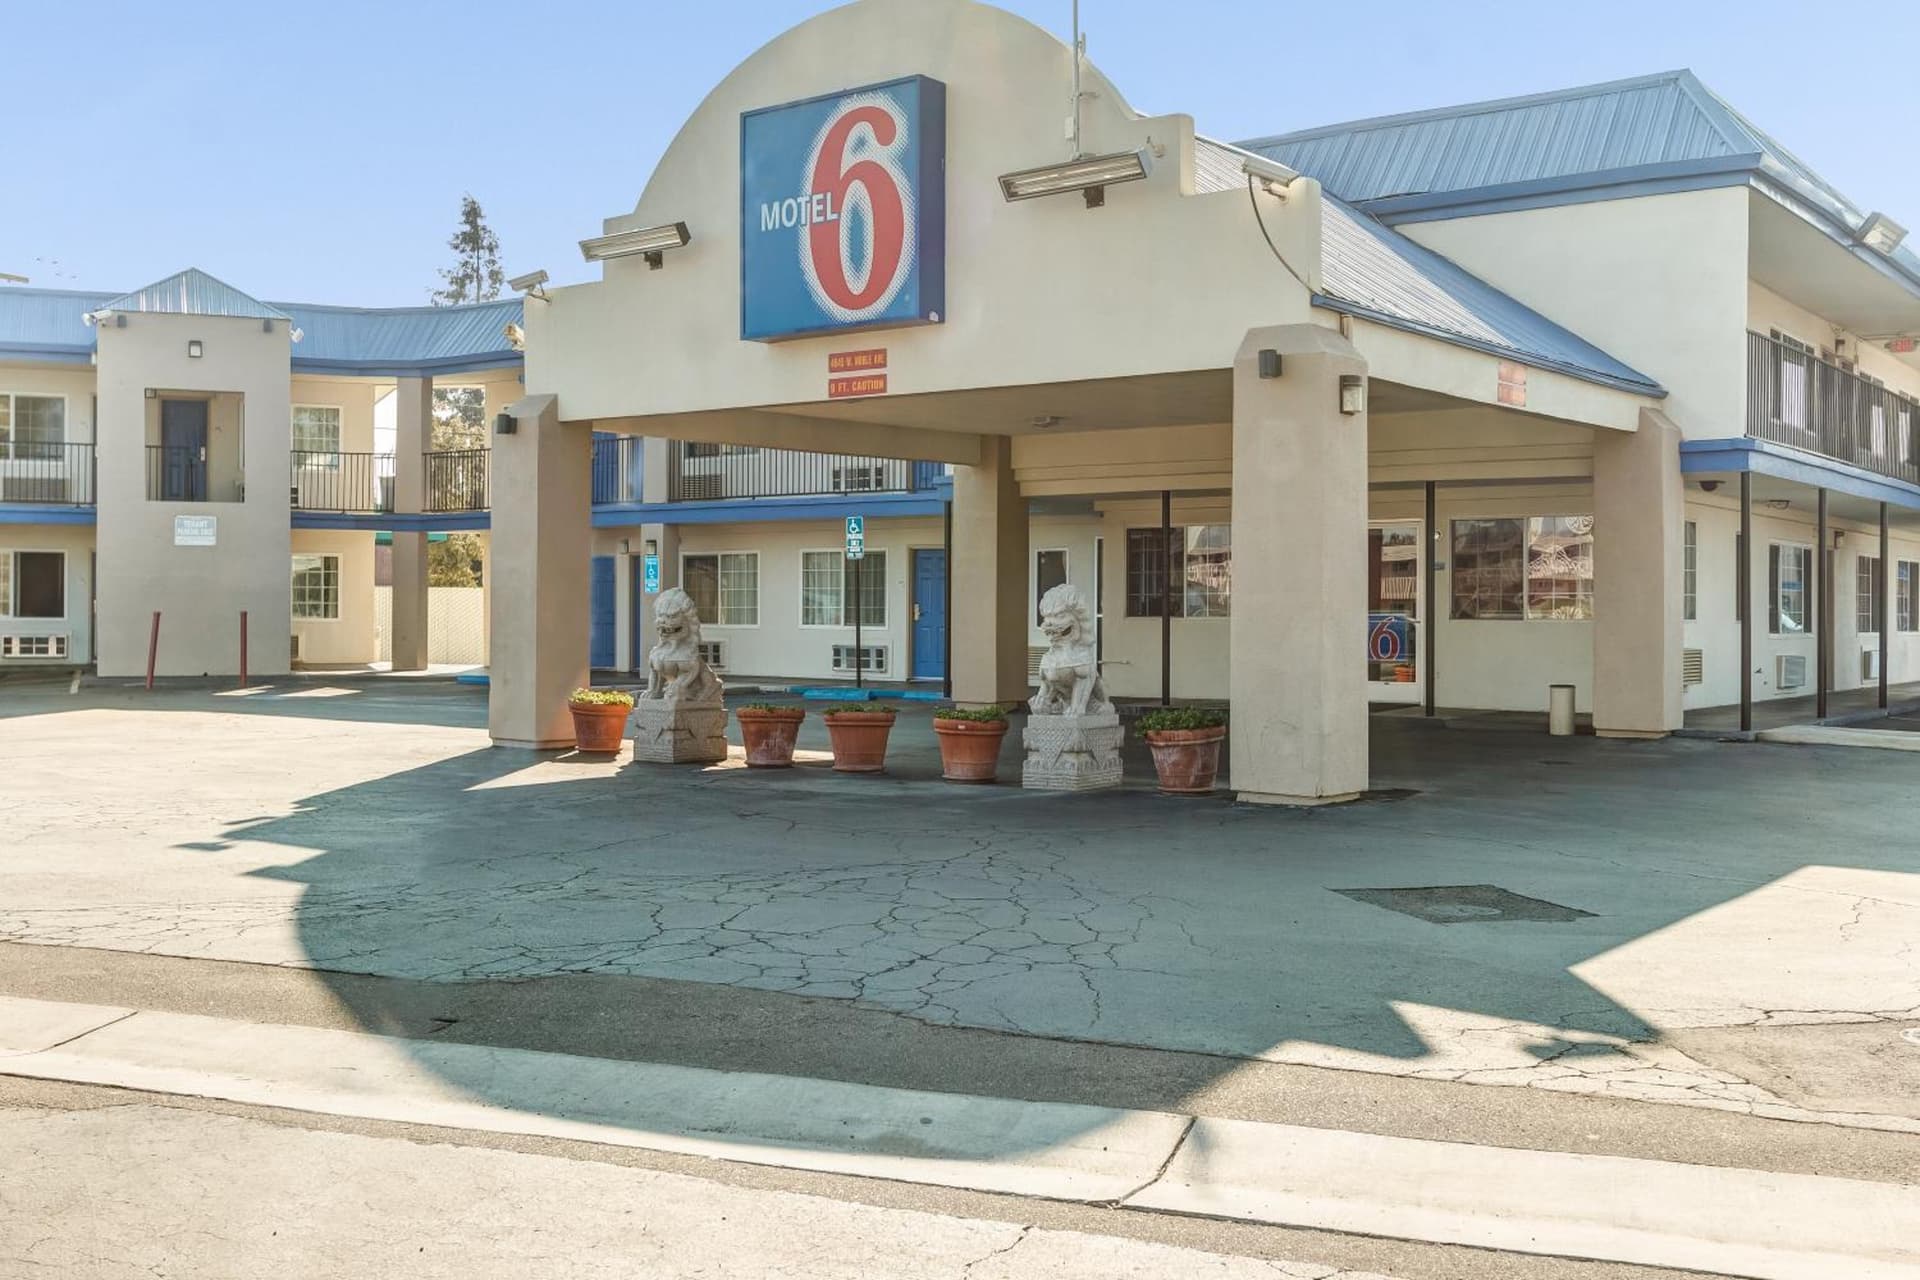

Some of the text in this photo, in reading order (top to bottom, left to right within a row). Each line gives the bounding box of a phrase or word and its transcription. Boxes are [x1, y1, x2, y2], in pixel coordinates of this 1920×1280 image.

[761, 106, 905, 311] MOTEL 6
[852, 379, 885, 391] CAUTION
[1369, 616, 1400, 660] 6
